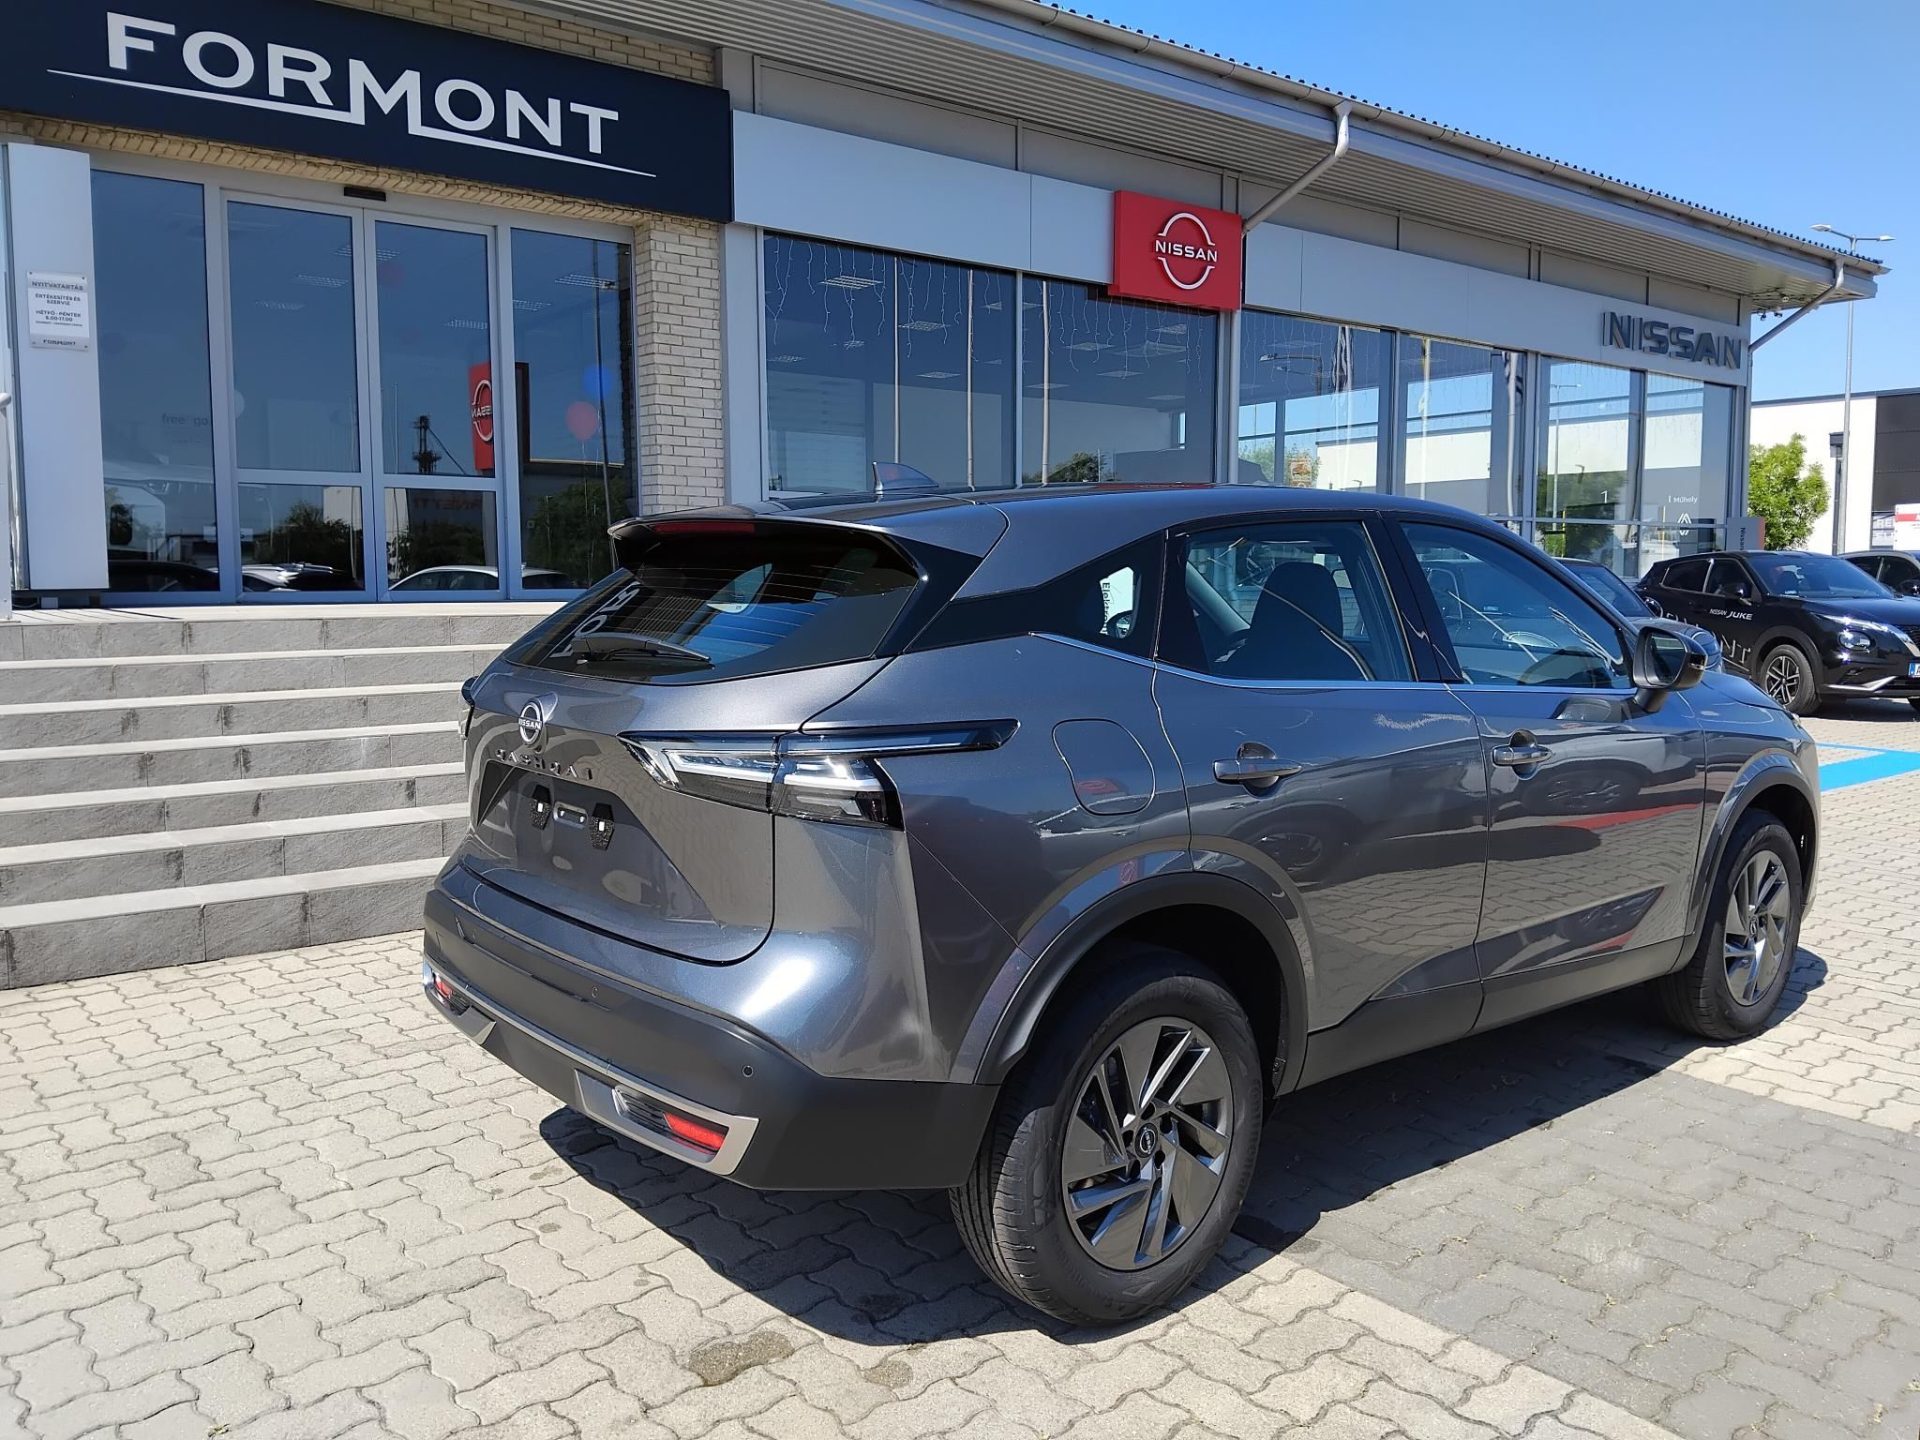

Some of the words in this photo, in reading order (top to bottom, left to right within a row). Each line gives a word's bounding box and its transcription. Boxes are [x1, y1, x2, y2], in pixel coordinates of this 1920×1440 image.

[105, 10, 620, 155] FORMONT
[1155, 239, 1218, 263] NISSAN
[1602, 311, 1742, 370] NISSAN
[1726, 610, 1754, 621] JUKE
